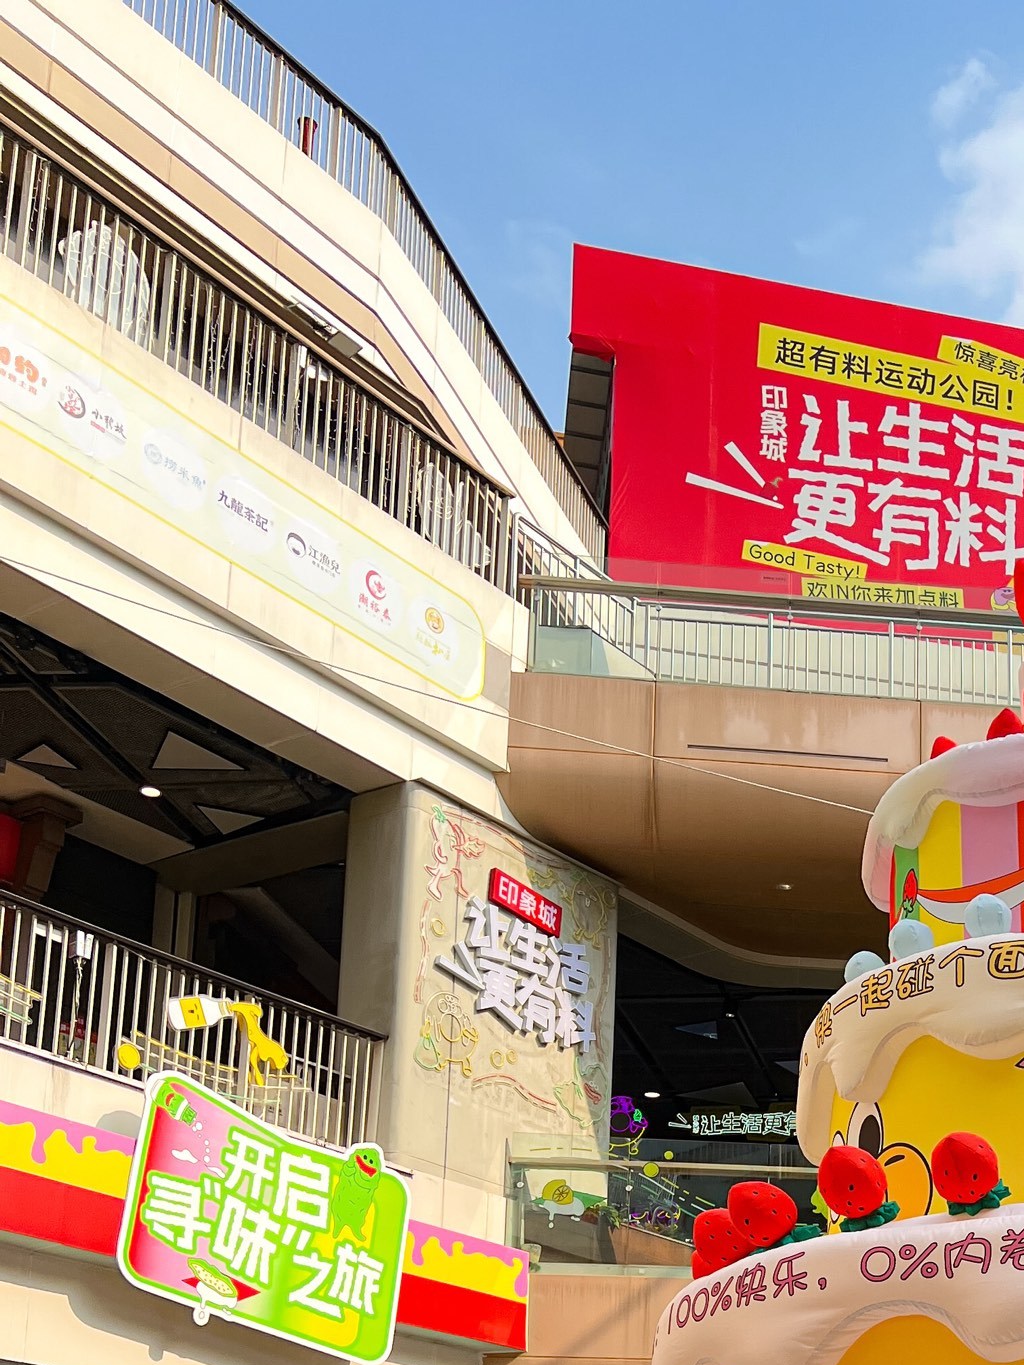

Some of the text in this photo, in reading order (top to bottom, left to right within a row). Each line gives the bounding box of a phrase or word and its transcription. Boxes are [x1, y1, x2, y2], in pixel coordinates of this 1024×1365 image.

[775, 337, 1014, 411] 超有料运动公园！
[760, 385, 787, 463] 印象城
[218, 490, 268, 532] 九龍茶記
[748, 544, 861, 580] Good Tasty!
[499, 875, 559, 932] 印象城
[466, 896, 590, 996] 让生活
[476, 956, 597, 1053] 更有料
[223, 1130, 331, 1231] 开启
